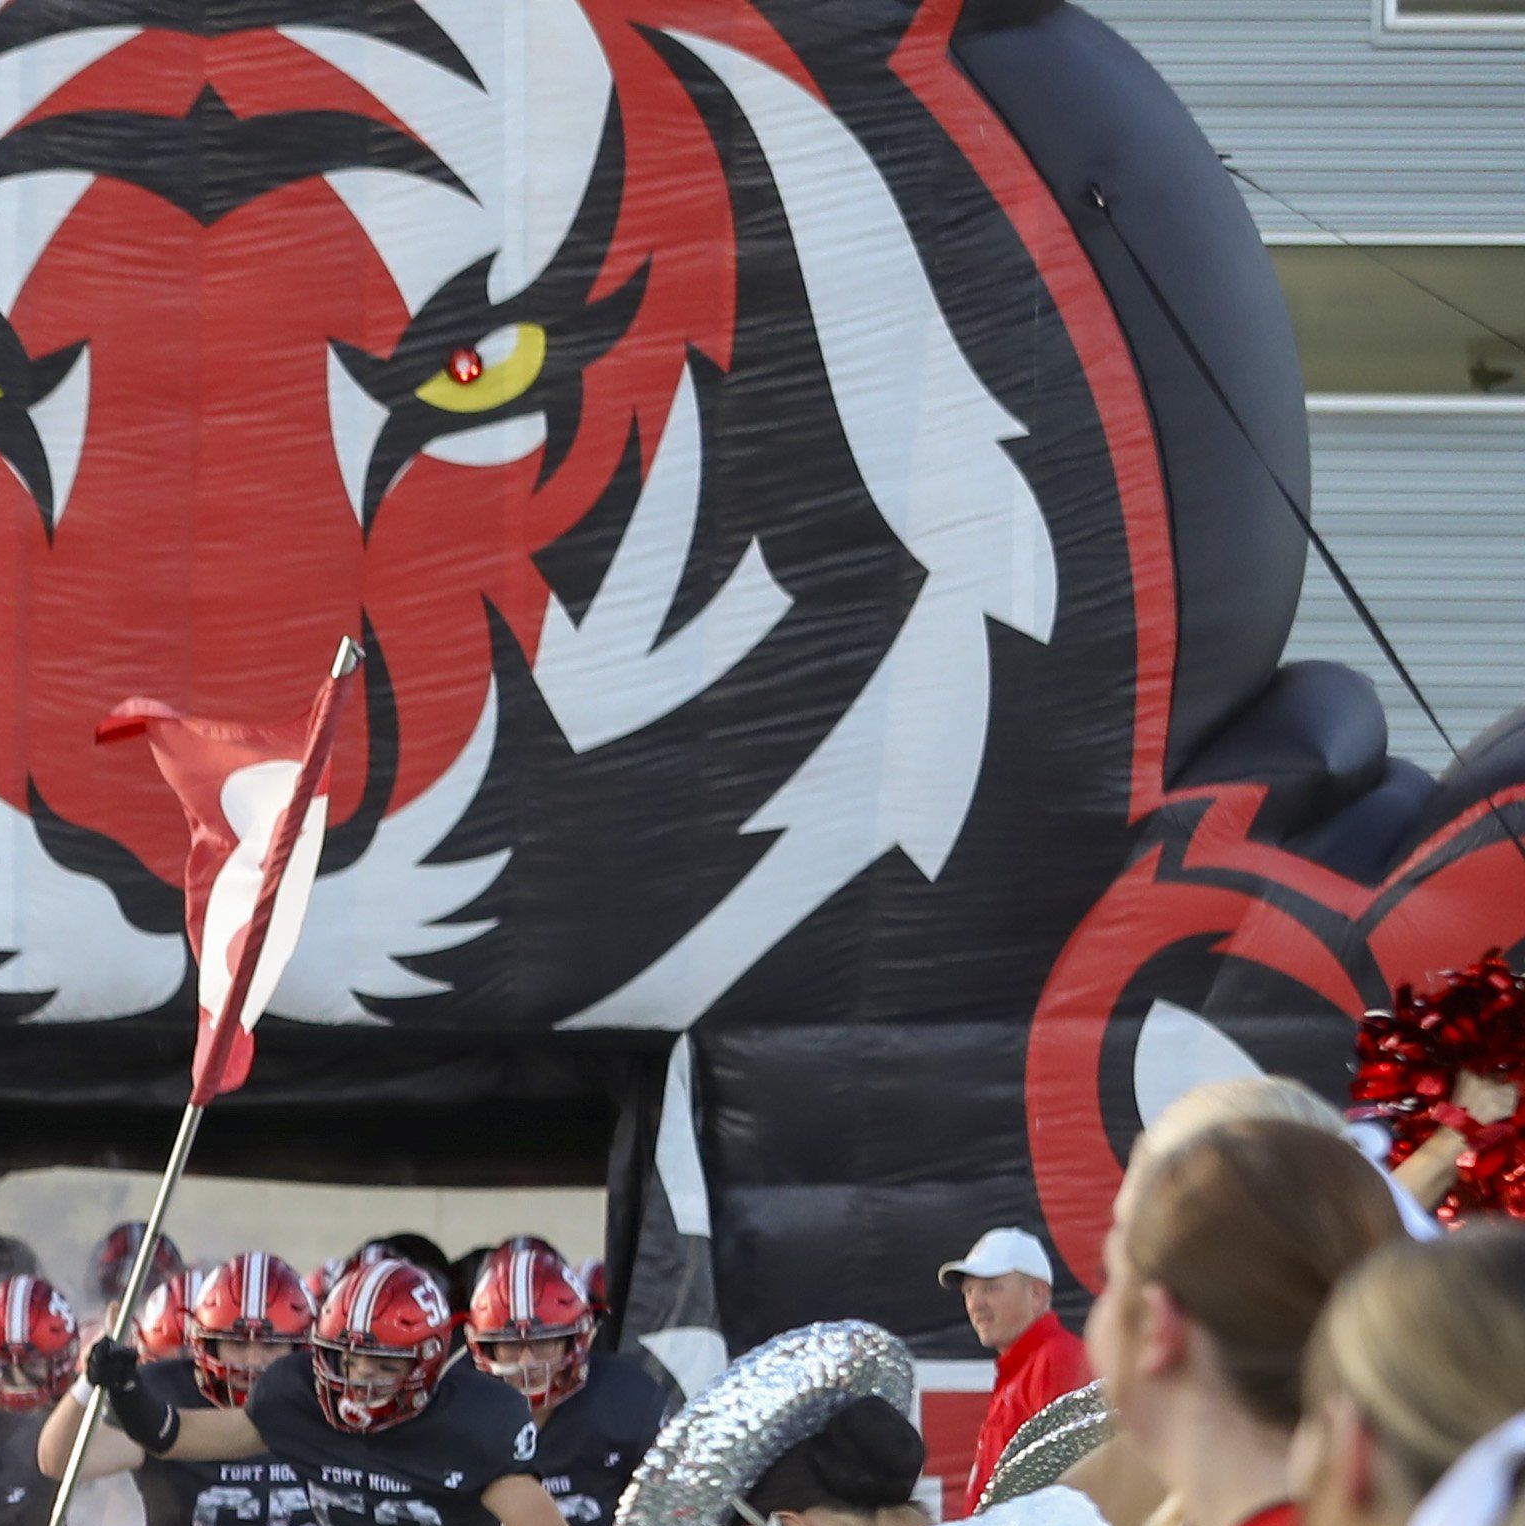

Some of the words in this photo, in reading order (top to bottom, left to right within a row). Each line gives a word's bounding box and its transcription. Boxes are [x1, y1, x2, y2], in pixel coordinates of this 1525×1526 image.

[220, 1464, 263, 1481] FORT
[269, 1463, 298, 1481] HO
[321, 1465, 363, 1487] FORT
[541, 1474, 572, 1492] OOD
